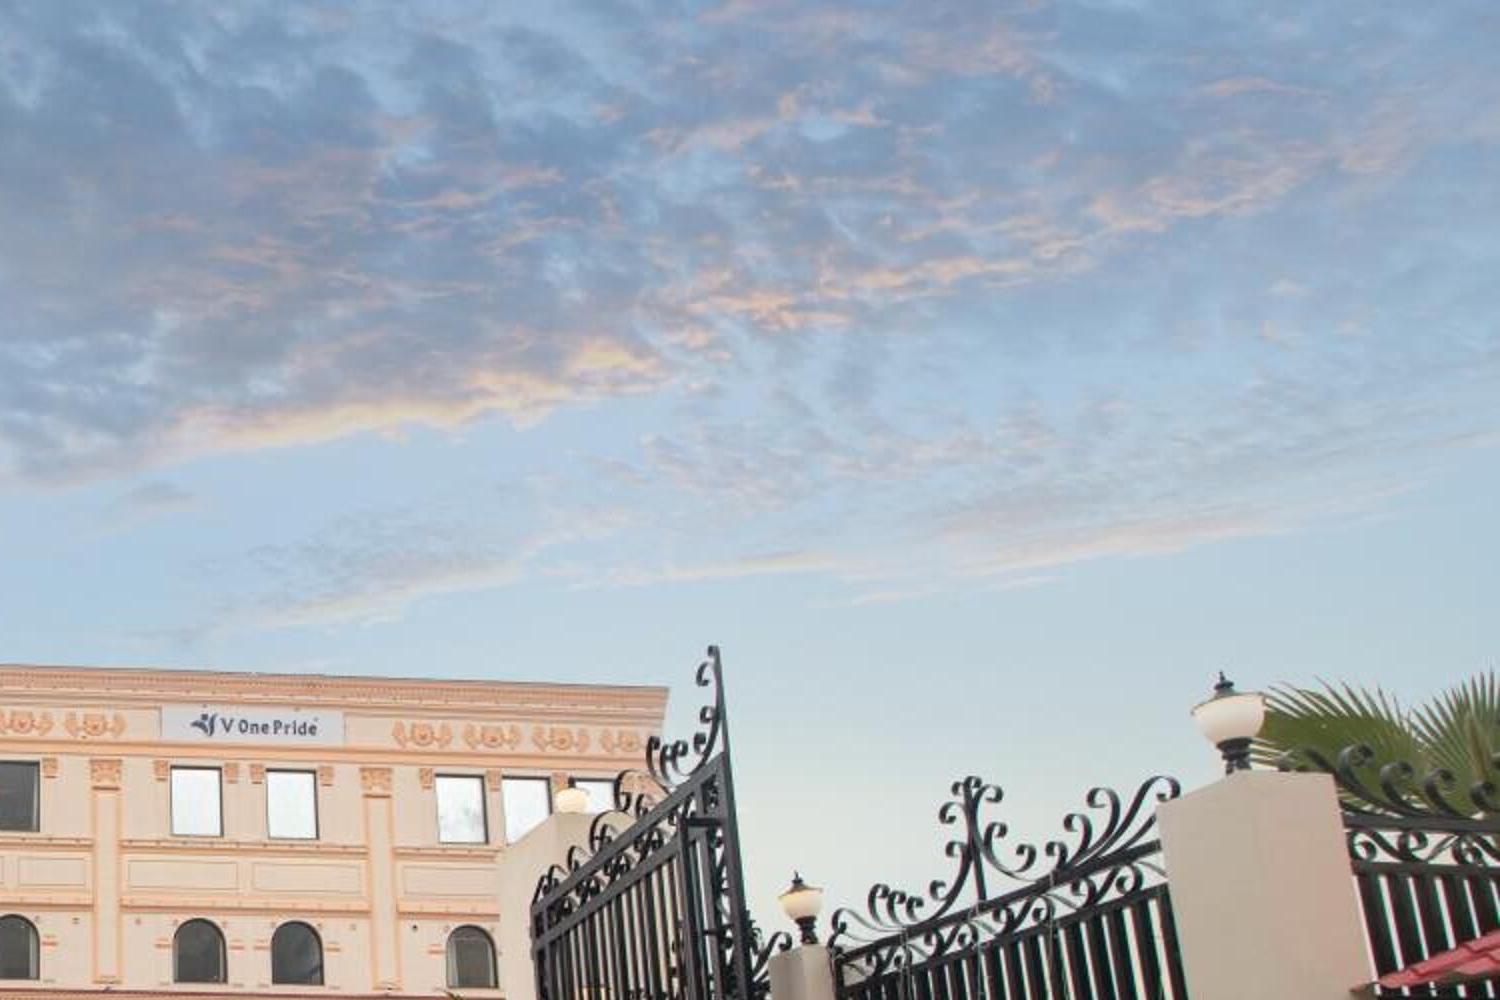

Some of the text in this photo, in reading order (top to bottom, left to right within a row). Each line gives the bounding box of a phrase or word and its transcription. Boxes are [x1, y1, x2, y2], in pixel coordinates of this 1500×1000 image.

[220, 718, 318, 736] V One Pride
